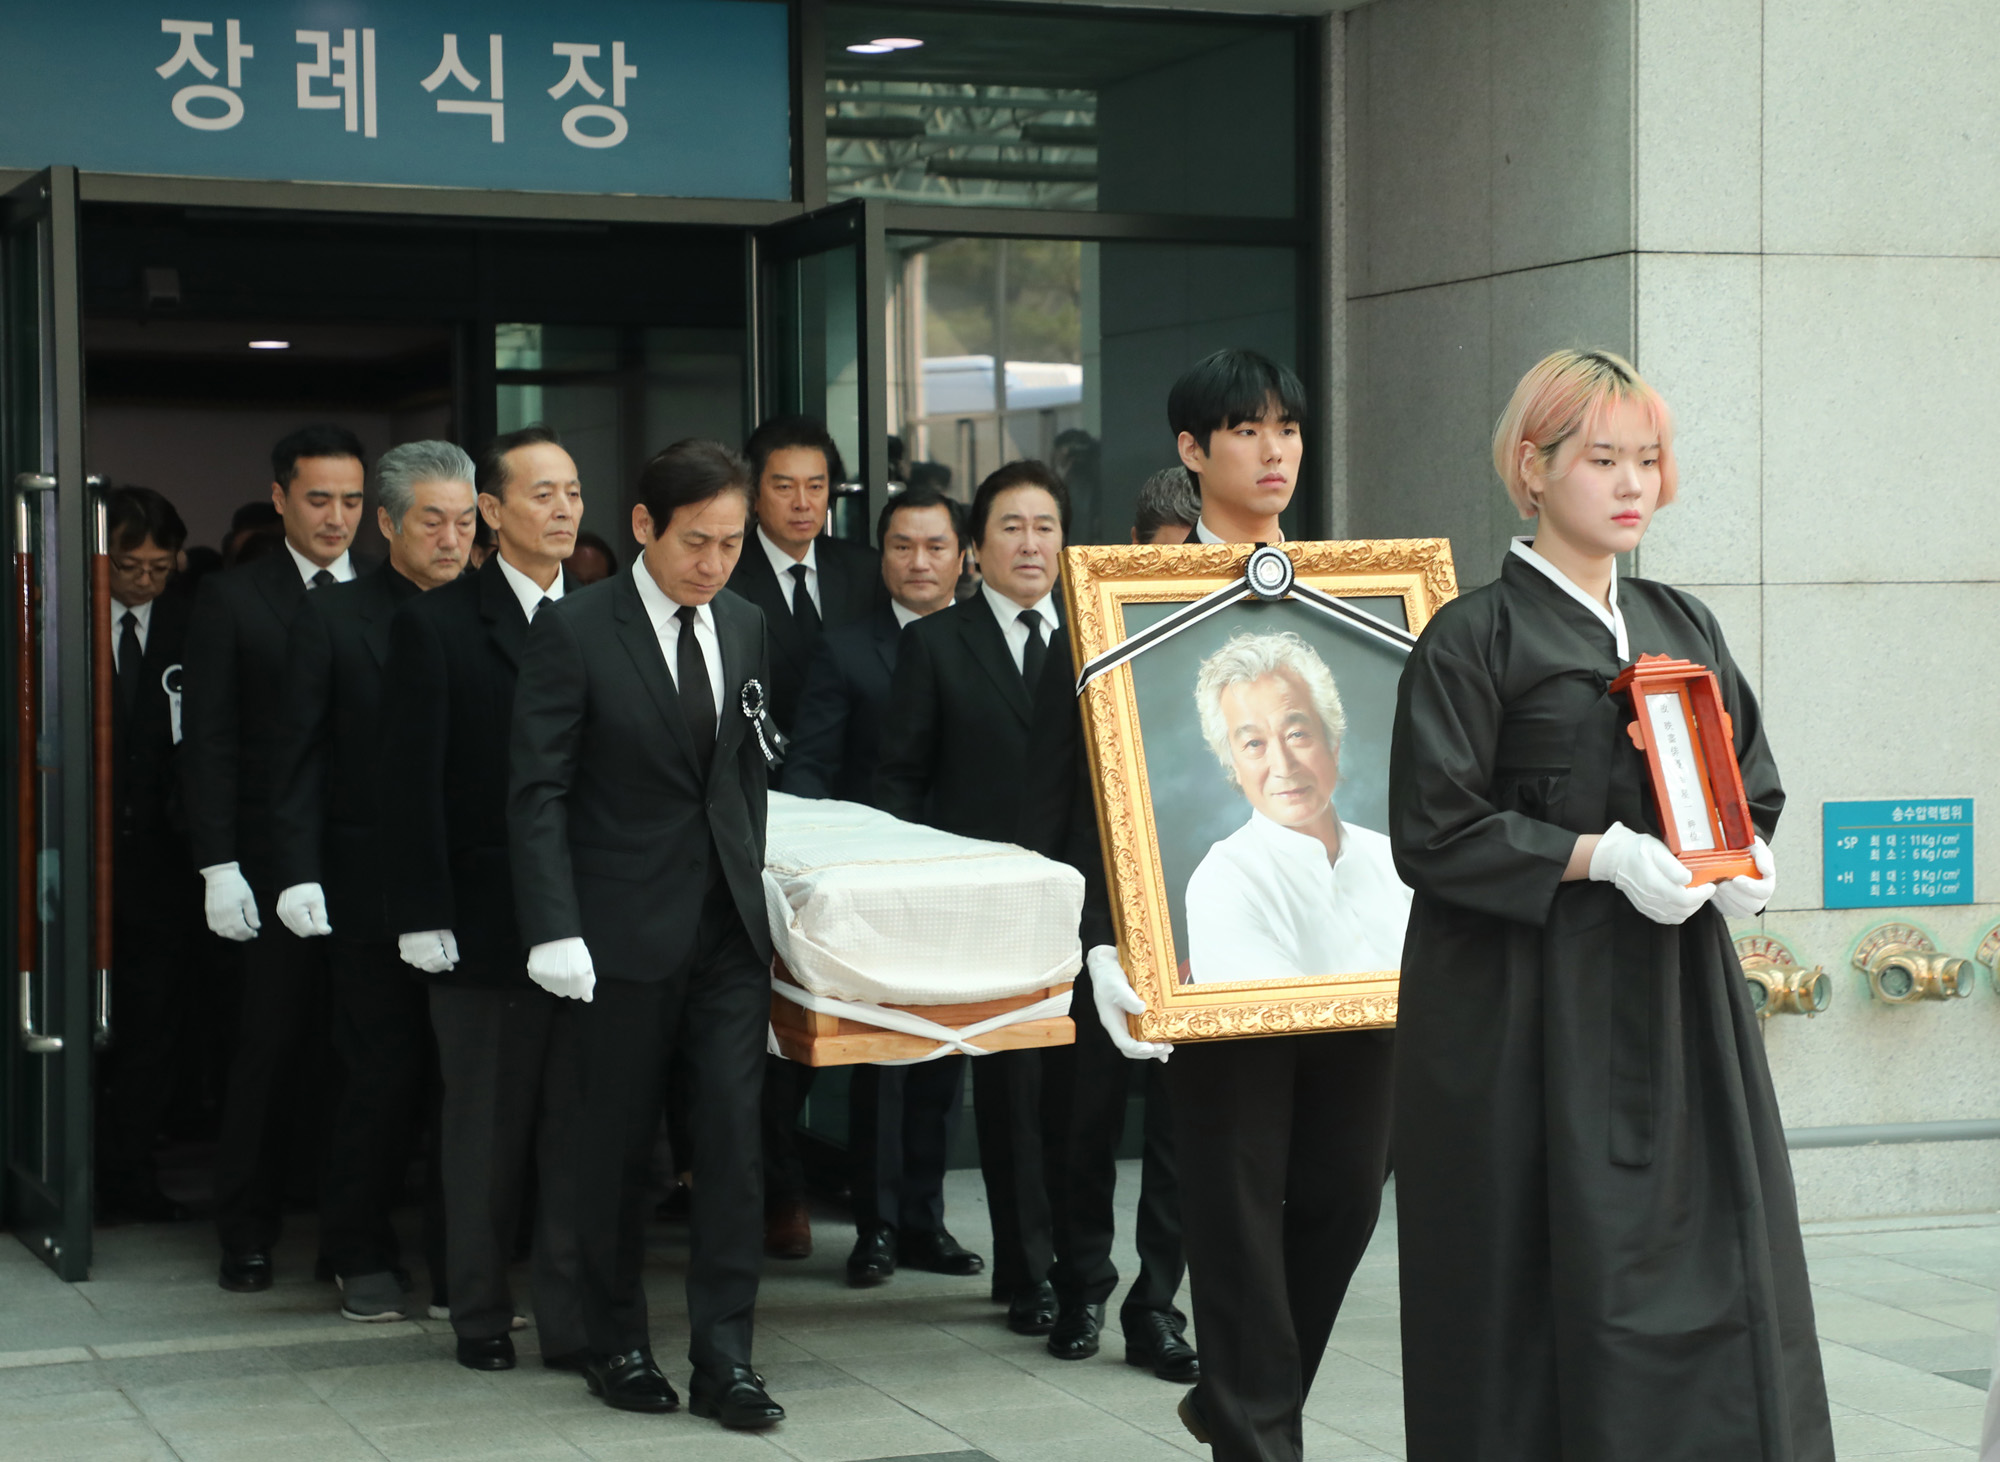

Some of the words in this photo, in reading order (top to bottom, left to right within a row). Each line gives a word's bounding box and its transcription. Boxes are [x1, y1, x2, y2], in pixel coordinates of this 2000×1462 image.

[155, 19, 637, 148] 장례식장
[1892, 805, 1962, 821] 송수압력범위
[1844, 836, 1859, 849] SP
[1844, 871, 1854, 884] H
